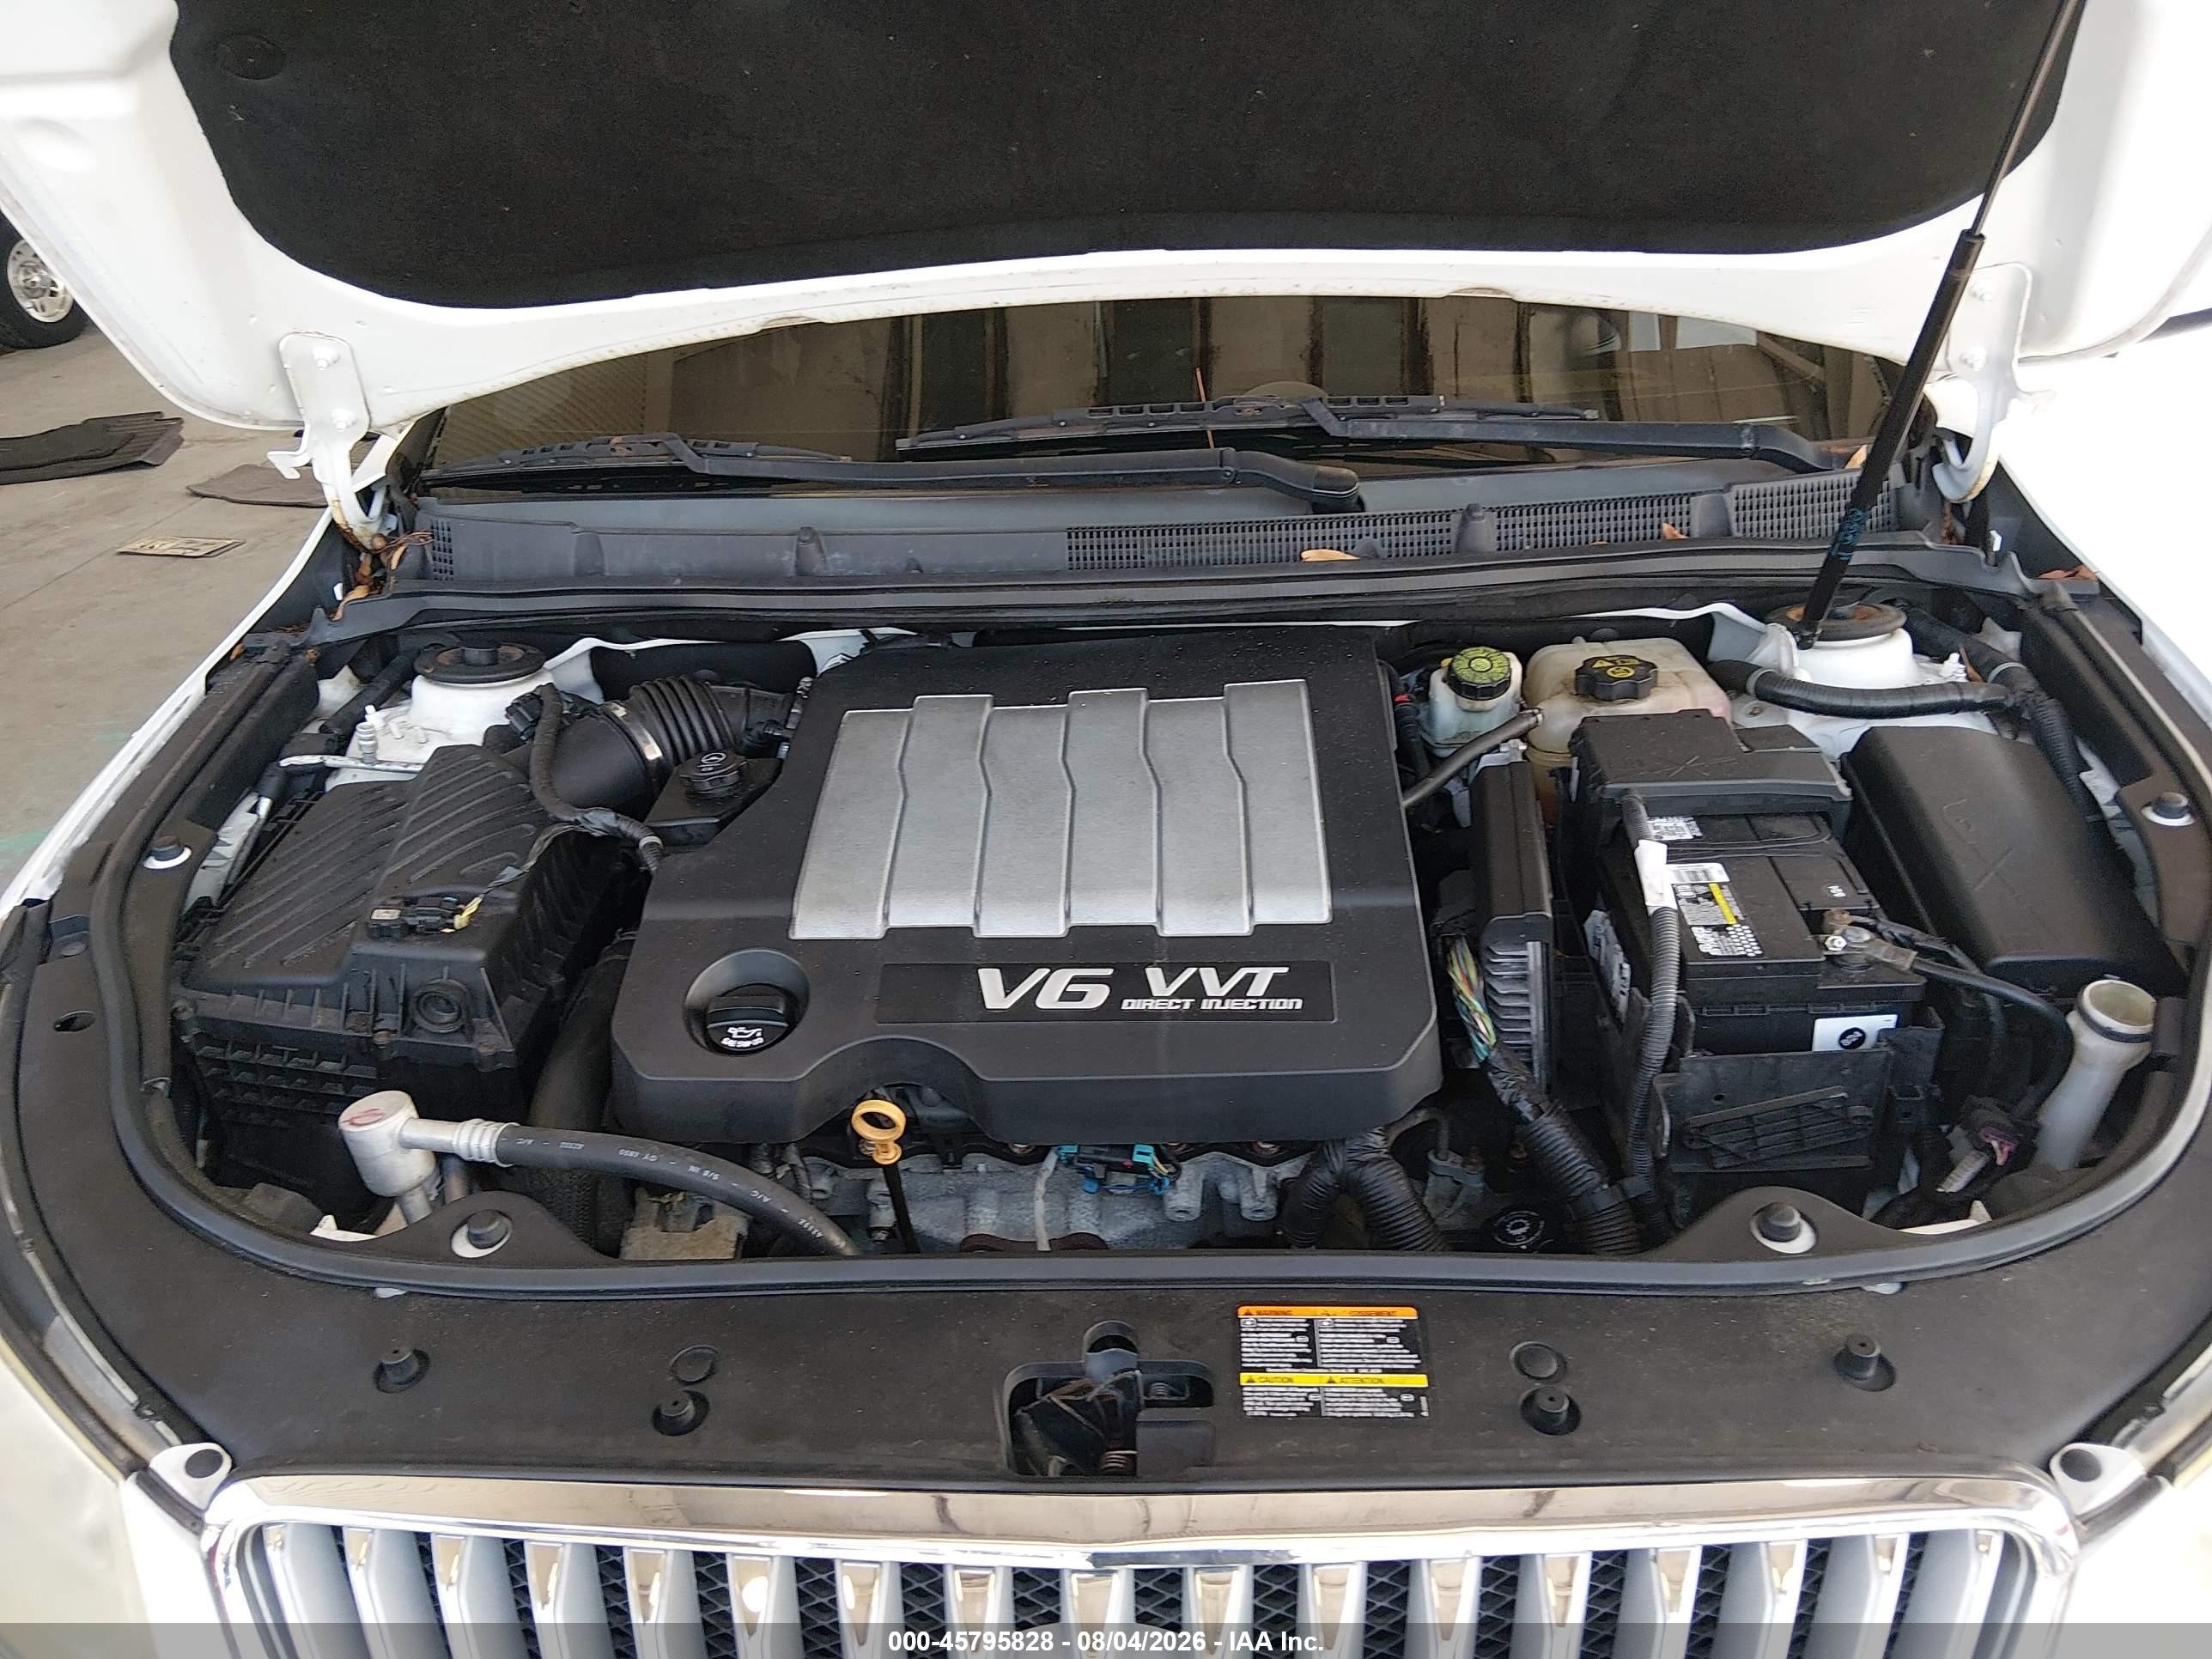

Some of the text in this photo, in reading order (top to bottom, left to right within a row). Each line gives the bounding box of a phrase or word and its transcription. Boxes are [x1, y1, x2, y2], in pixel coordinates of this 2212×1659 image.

[977, 966, 1290, 1011] V6 VVT
[1121, 999, 1304, 1010] DIRECT INJECTION
[750, 1190, 772, 1203] A/C
